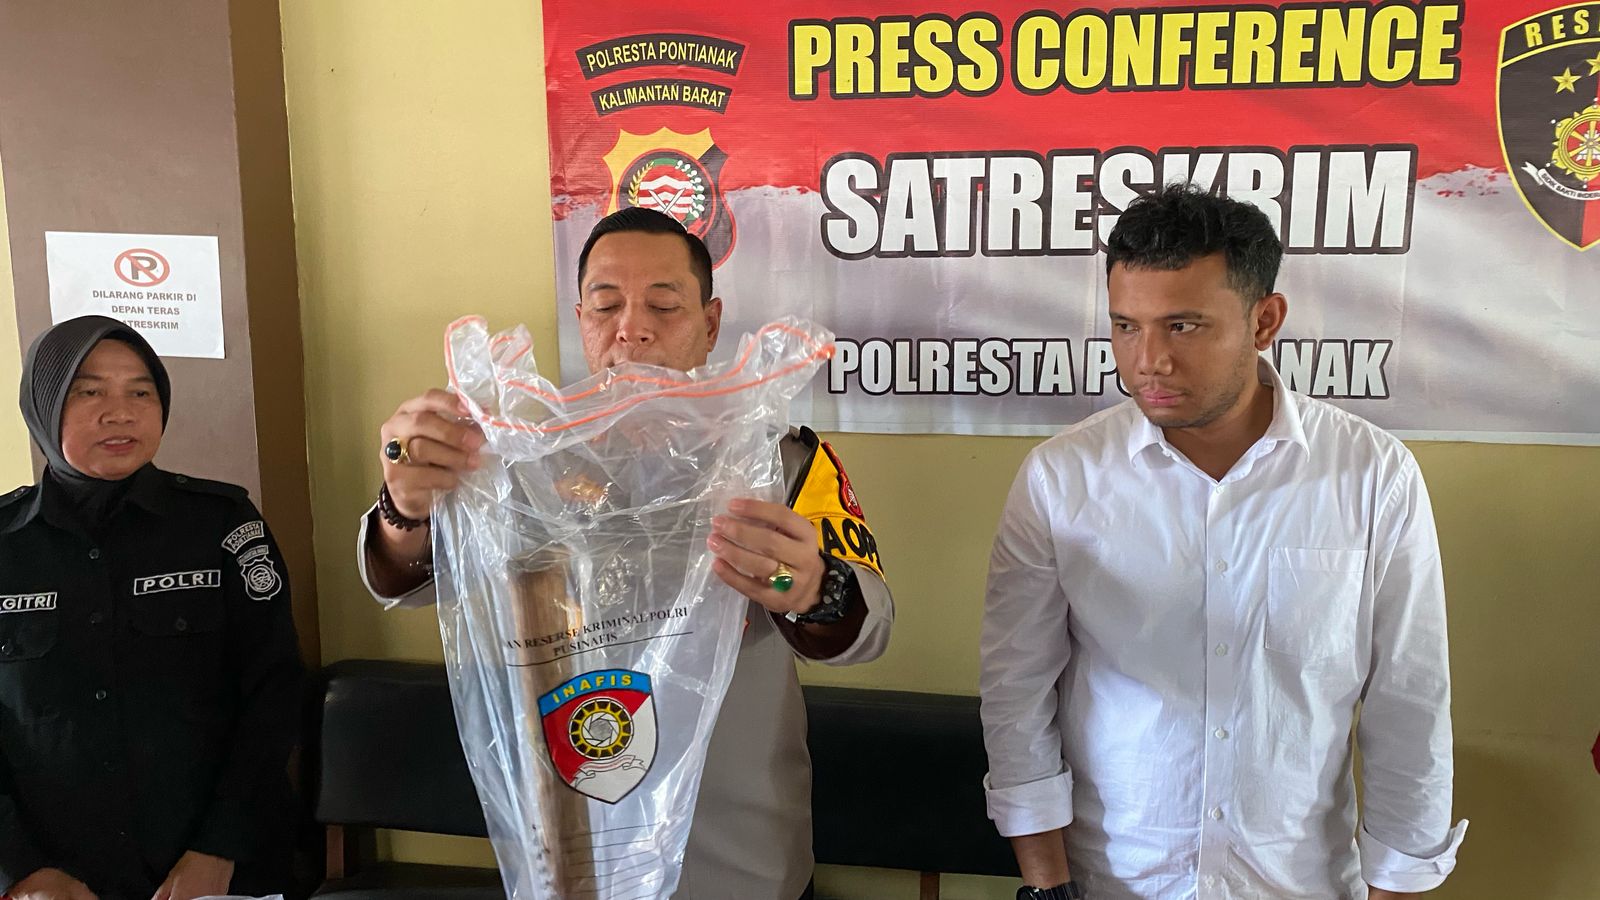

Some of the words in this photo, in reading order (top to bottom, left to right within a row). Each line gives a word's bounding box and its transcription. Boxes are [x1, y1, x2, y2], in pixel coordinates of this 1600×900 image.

[1524, 9, 1600, 48] RES
[586, 42, 657, 72] POLRESTA
[659, 41, 738, 69] PONTIANAK
[792, 16, 999, 97] PRESS
[1013, 4, 1460, 92] CONFERENCE
[599, 84, 680, 110] KALIMANTAN
[683, 85, 726, 108] BARAT
[92, 290, 144, 300] DILARANG
[146, 291, 184, 301] PARKIR
[186, 293, 197, 302] DI
[111, 305, 144, 314] DEPAN
[147, 306, 180, 316] TERAS
[828, 339, 1076, 395] POLRESTA
[227, 523, 260, 545] POLRESTA
[143, 572, 213, 591] POLRI
[0, 594, 51, 610] GITRI
[583, 612, 648, 634] KRIMINAL
[650, 606, 688, 621] POLRI
[553, 674, 632, 703] INAFIS
